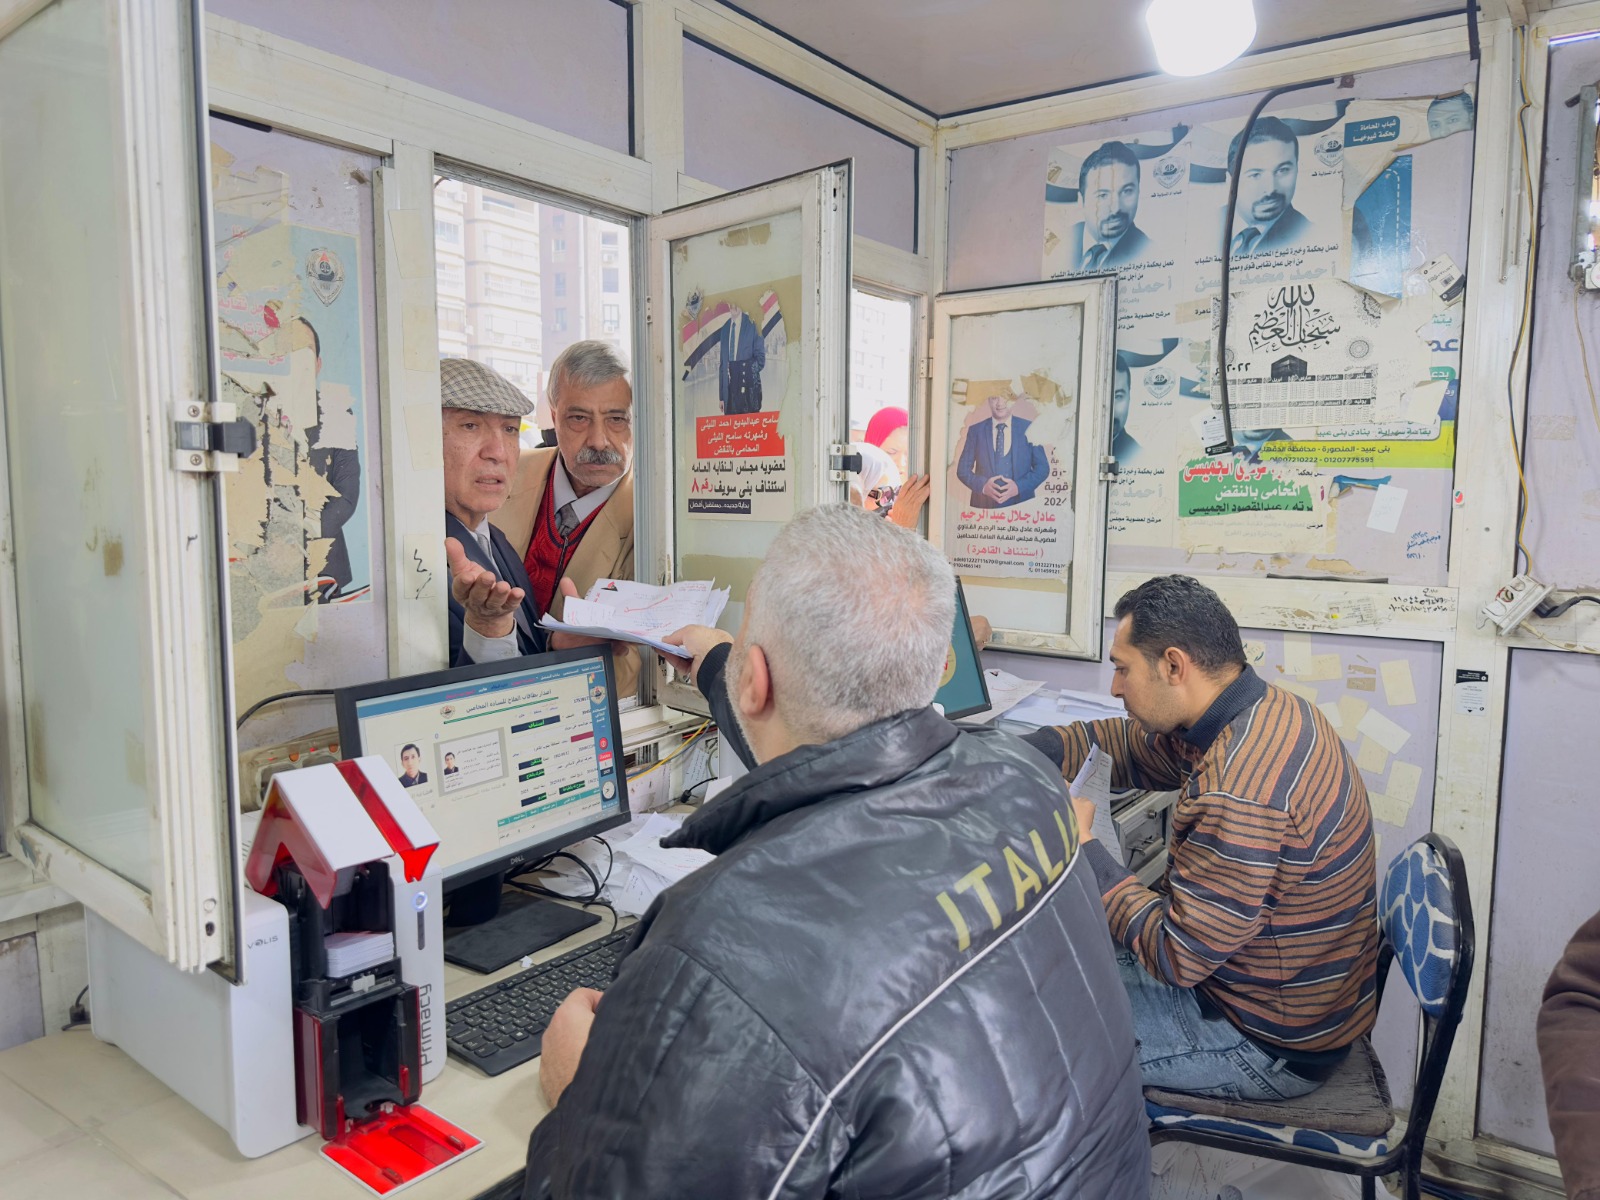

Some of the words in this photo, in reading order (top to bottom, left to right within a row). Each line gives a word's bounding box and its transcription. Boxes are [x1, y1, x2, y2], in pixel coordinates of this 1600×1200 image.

[1306, 245, 1325, 253] بحكمة
[707, 432, 725, 445] الليثى
[725, 431, 742, 444] سامح
[743, 429, 769, 442] وشهرته
[713, 445, 735, 456] بالنقض
[736, 444, 760, 456] المحامى
[1321, 446, 1356, 454] المنصورة
[1360, 446, 1376, 454] عبيد
[735, 460, 759, 476] مجلس
[691, 477, 700, 494] ٨
[701, 477, 713, 494] رقم
[713, 480, 737, 497] سويف
[738, 480, 753, 498] بنى
[755, 480, 787, 493] استئناف
[1044, 481, 1069, 493] قوية
[1260, 484, 1300, 500] المحامى
[1214, 484, 1259, 502] بالنقض
[960, 509, 989, 522] الرحيم
[990, 510, 1006, 523] عبد
[1007, 509, 1031, 523] جلال
[1032, 510, 1056, 524] عادل
[977, 523, 996, 532] الرحيم
[1033, 526, 1057, 535] وشهرته
[1033, 536, 1057, 544] لعضوية
[971, 544, 1002, 556] القاهرة
[246, 934, 279, 950] VOLIS
